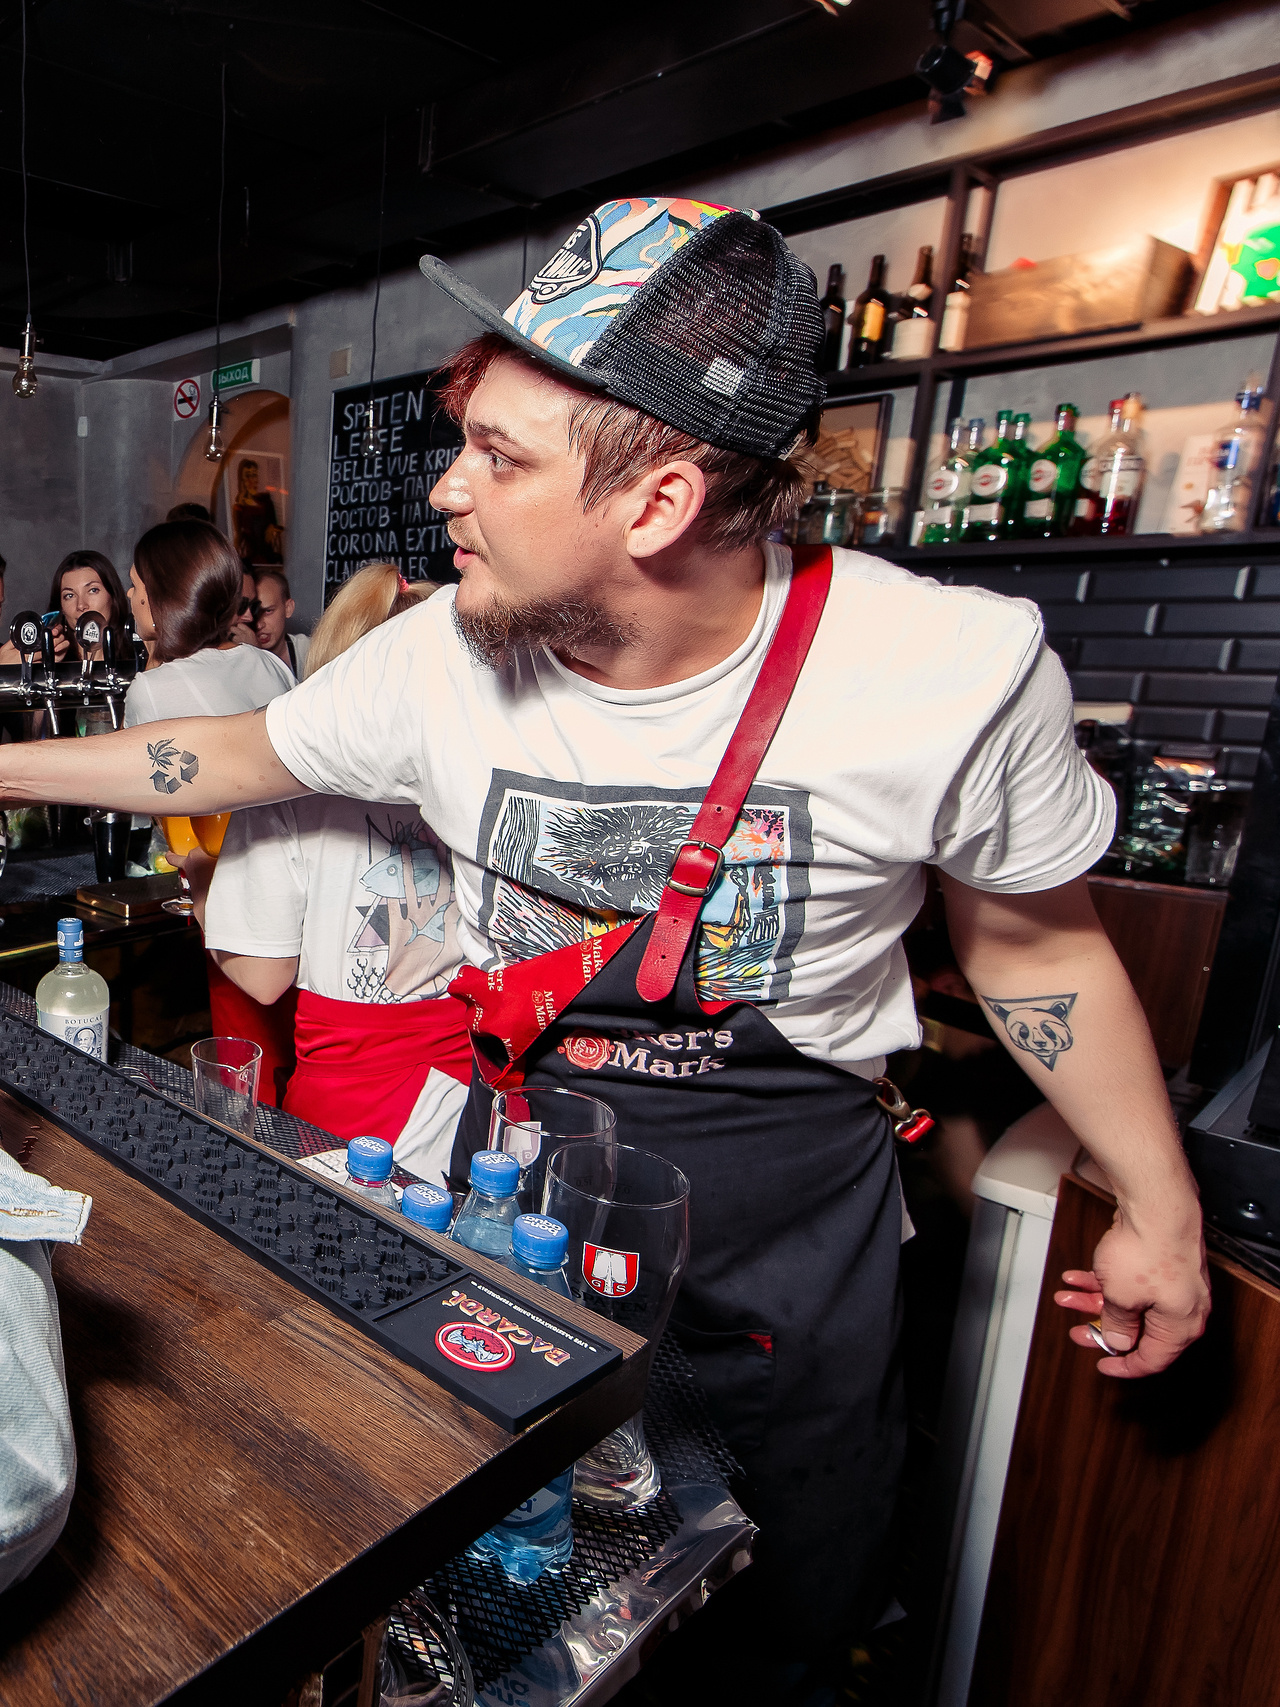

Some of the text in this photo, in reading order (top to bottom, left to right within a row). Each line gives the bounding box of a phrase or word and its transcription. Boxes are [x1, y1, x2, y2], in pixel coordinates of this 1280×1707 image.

[218, 366, 249, 384] ЫХОД
[328, 531, 399, 556] CORONA
[496, 971, 504, 992] er's
[608, 1041, 726, 1078] Mark
